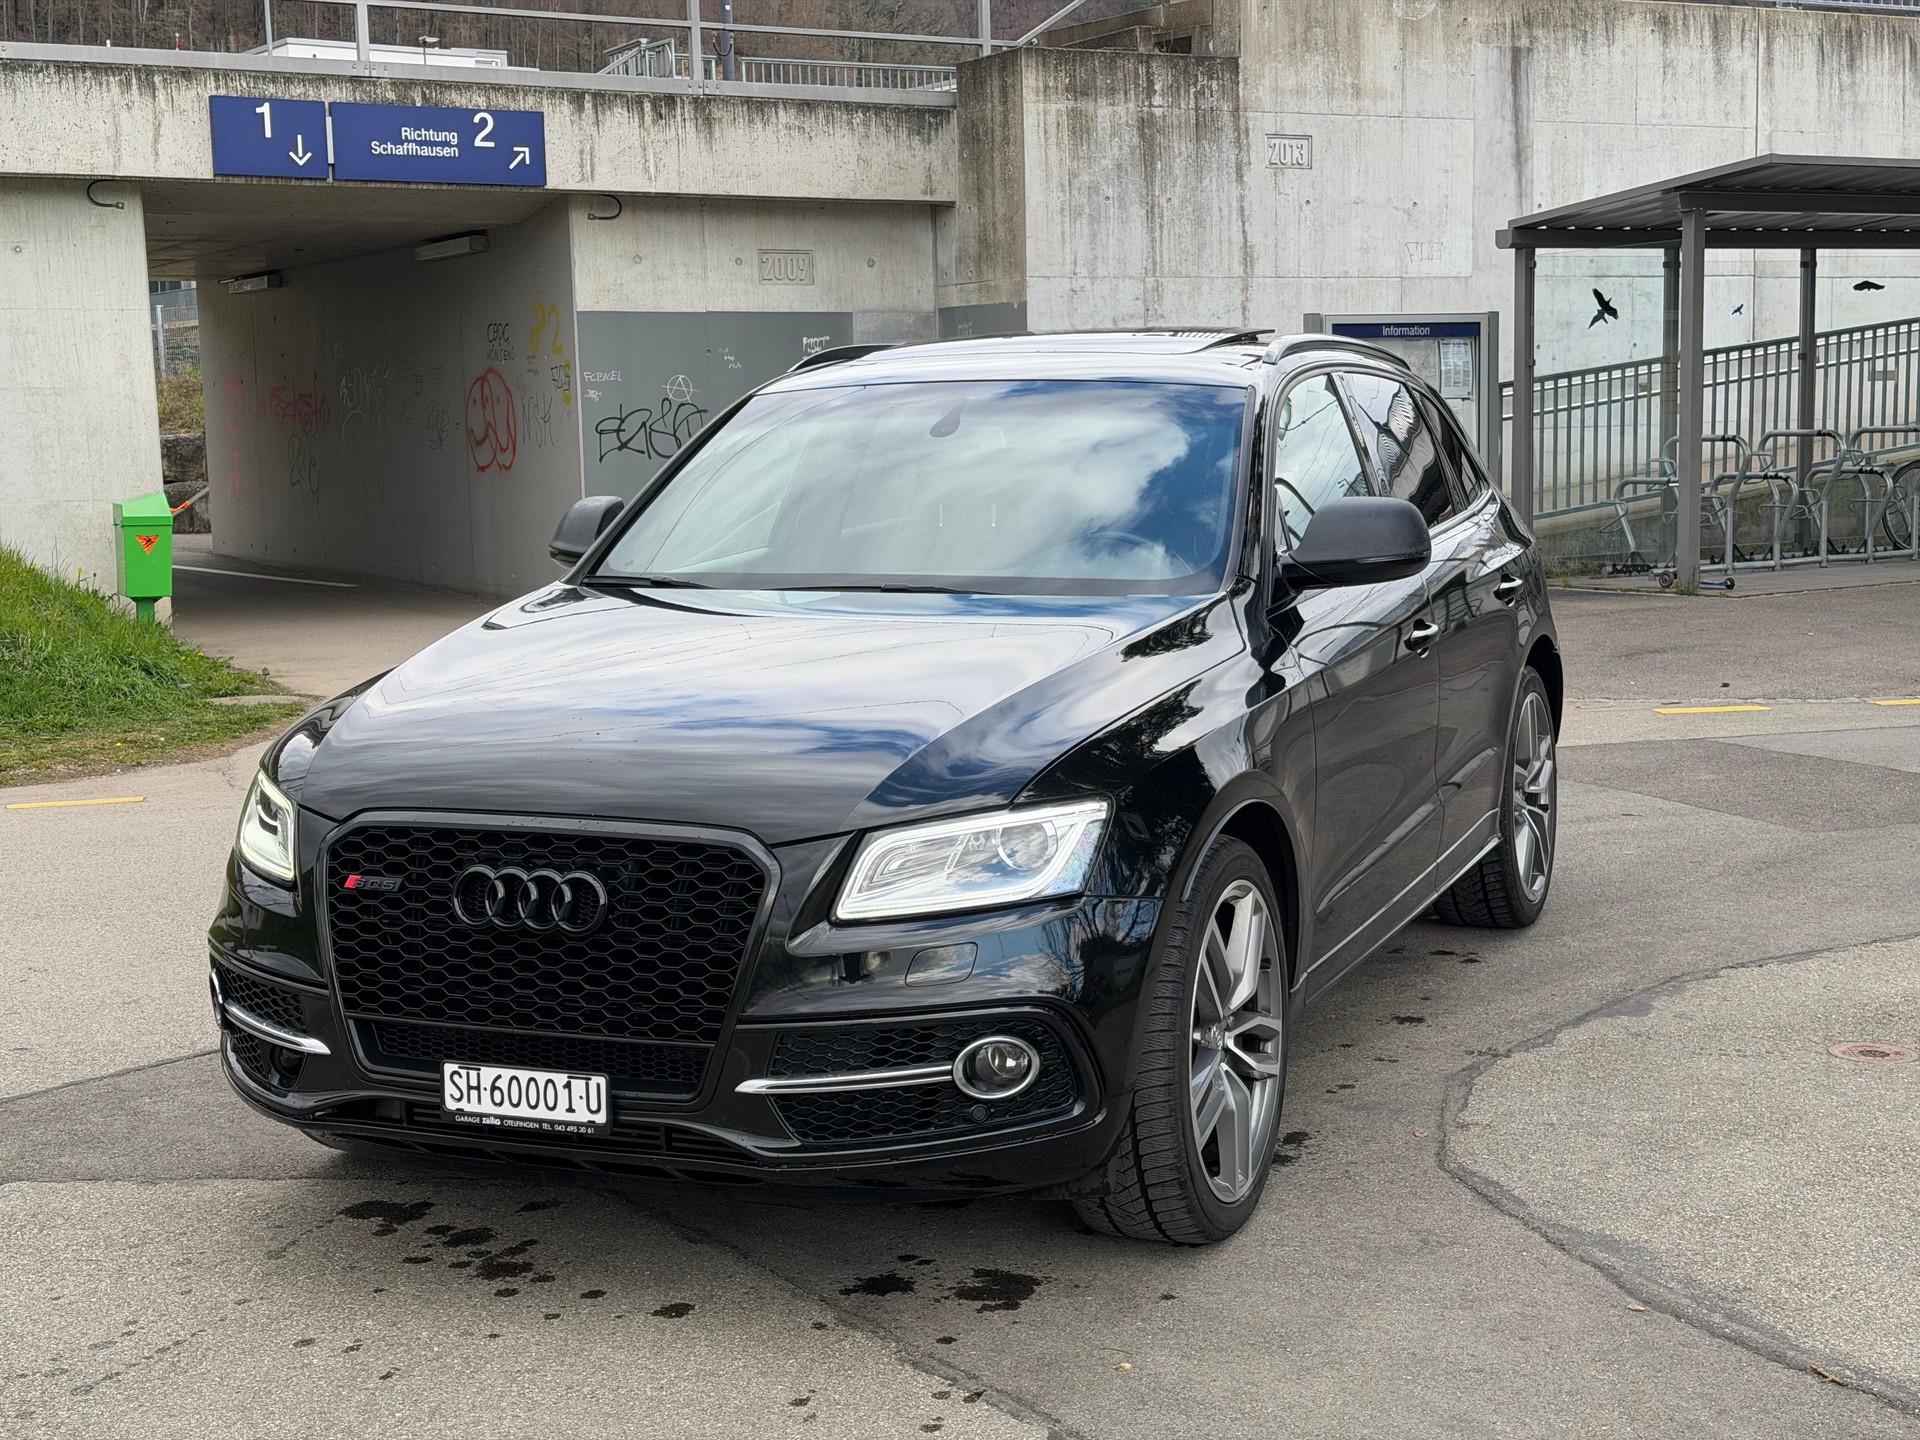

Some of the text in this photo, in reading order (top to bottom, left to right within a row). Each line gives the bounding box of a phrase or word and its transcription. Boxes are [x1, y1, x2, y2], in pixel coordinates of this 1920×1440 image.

[255, 102, 272, 138] 1
[473, 112, 495, 147] 2
[401, 127, 458, 145] Richtung
[371, 141, 459, 158] Schaffhausen
[1268, 141, 1307, 166] 2013
[761, 256, 808, 281] 2009
[1382, 325, 1430, 336] Information
[455, 1115, 480, 1124] GARAGE
[503, 1119, 539, 1129] OTELFINGEN
[554, 1124, 565, 1132] 043
[566, 1125, 578, 1133] 495
